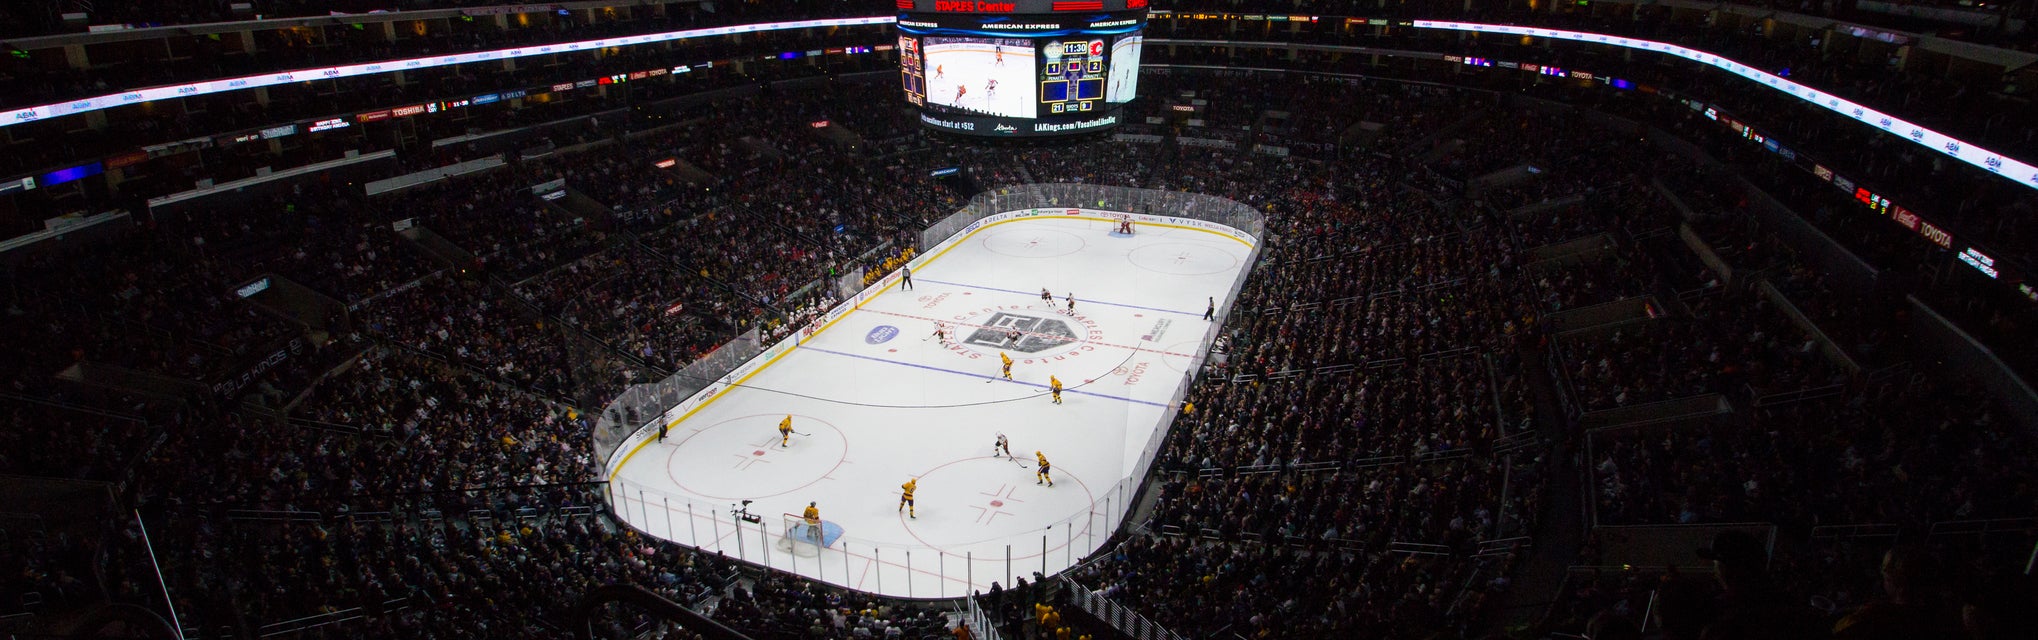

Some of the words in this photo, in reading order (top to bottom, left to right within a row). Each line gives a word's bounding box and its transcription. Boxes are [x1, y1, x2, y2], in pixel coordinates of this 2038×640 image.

[935, 1, 974, 12] STAPLES
[978, 1, 1016, 12] Center
[1065, 44, 1086, 53] 11:30
[1052, 64, 1056, 72] 1
[1093, 62, 1098, 70] 2
[649, 68, 667, 76] TOYOTA
[1571, 71, 1592, 79] TOYOTA
[553, 83, 573, 91] STAPLES
[507, 91, 526, 99] DELTA
[16, 111, 38, 119] ABM
[392, 105, 425, 117] TOSHIBA
[942, 120, 953, 128] start
[961, 122, 974, 130] $512
[1880, 118, 1892, 127] ABM
[1910, 129, 1924, 139] ABM
[1945, 142, 1960, 152] ABM
[1984, 156, 2002, 169] ABM
[988, 213, 1007, 223] DELTA
[965, 222, 980, 234] GEICO
[1920, 221, 1951, 249] TOYOTA
[954, 304, 1034, 321] Center
[1014, 345, 1095, 365] Cente
[252, 349, 287, 377] KINGS
[1123, 362, 1150, 386] TOYOTA
[698, 387, 718, 402] verizon
